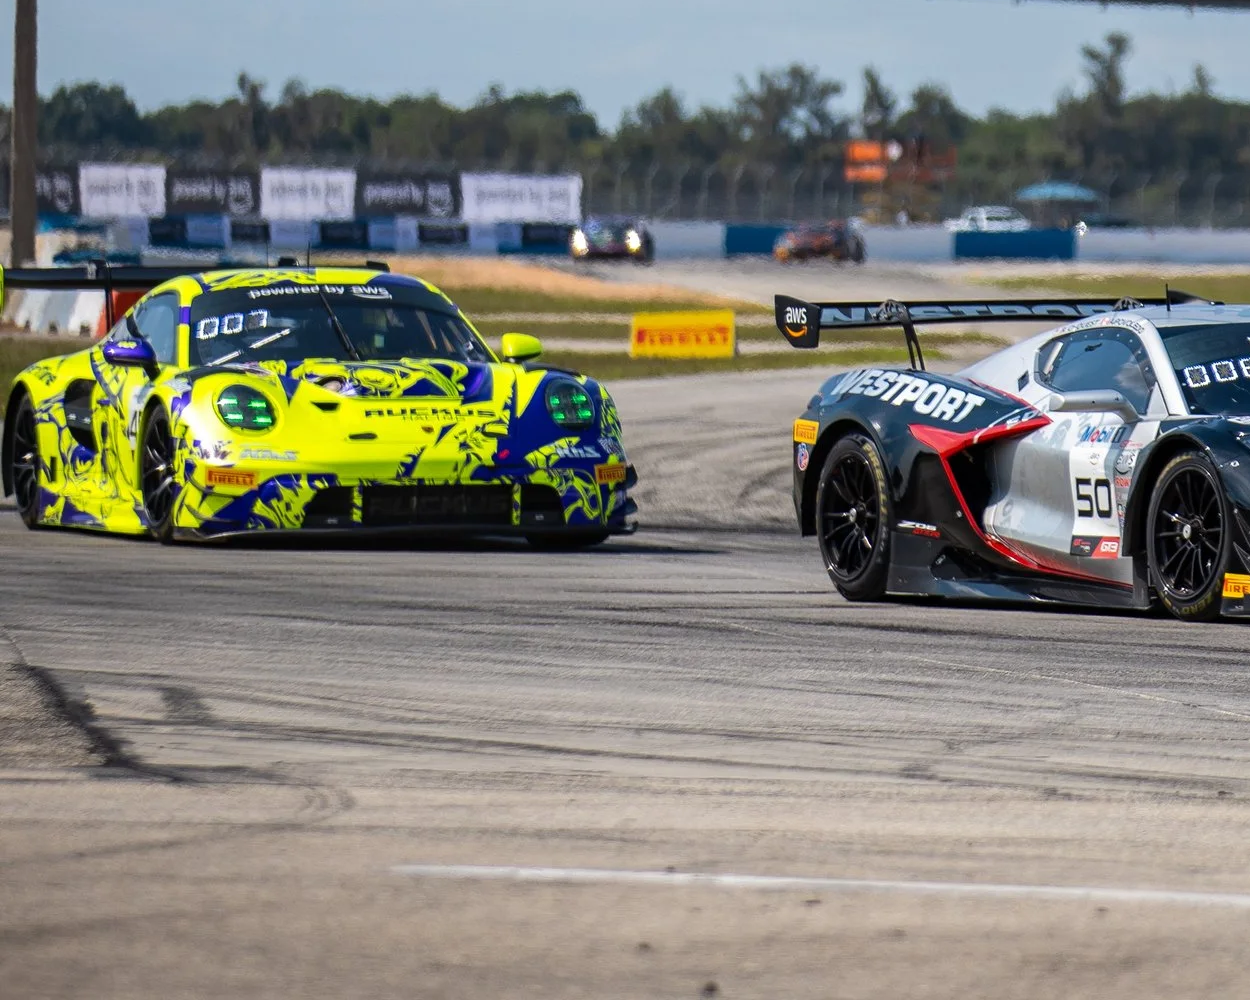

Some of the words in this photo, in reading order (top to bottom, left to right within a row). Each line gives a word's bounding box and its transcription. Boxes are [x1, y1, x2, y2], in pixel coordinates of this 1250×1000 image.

[249, 286, 319, 299] powered
[325, 284, 344, 295] by
[350, 286, 391, 299] aws
[785, 306, 807, 324] aws
[832, 368, 986, 423] WESTPORT
[365, 407, 496, 418] RUCKUS
[796, 424, 816, 439] PIRELLI
[1080, 426, 1115, 443] Mobil
[207, 470, 254, 485] PIRELLI
[599, 466, 625, 481] PIRELLI
[1076, 478, 1112, 517] 50
[897, 520, 936, 531] Z06
